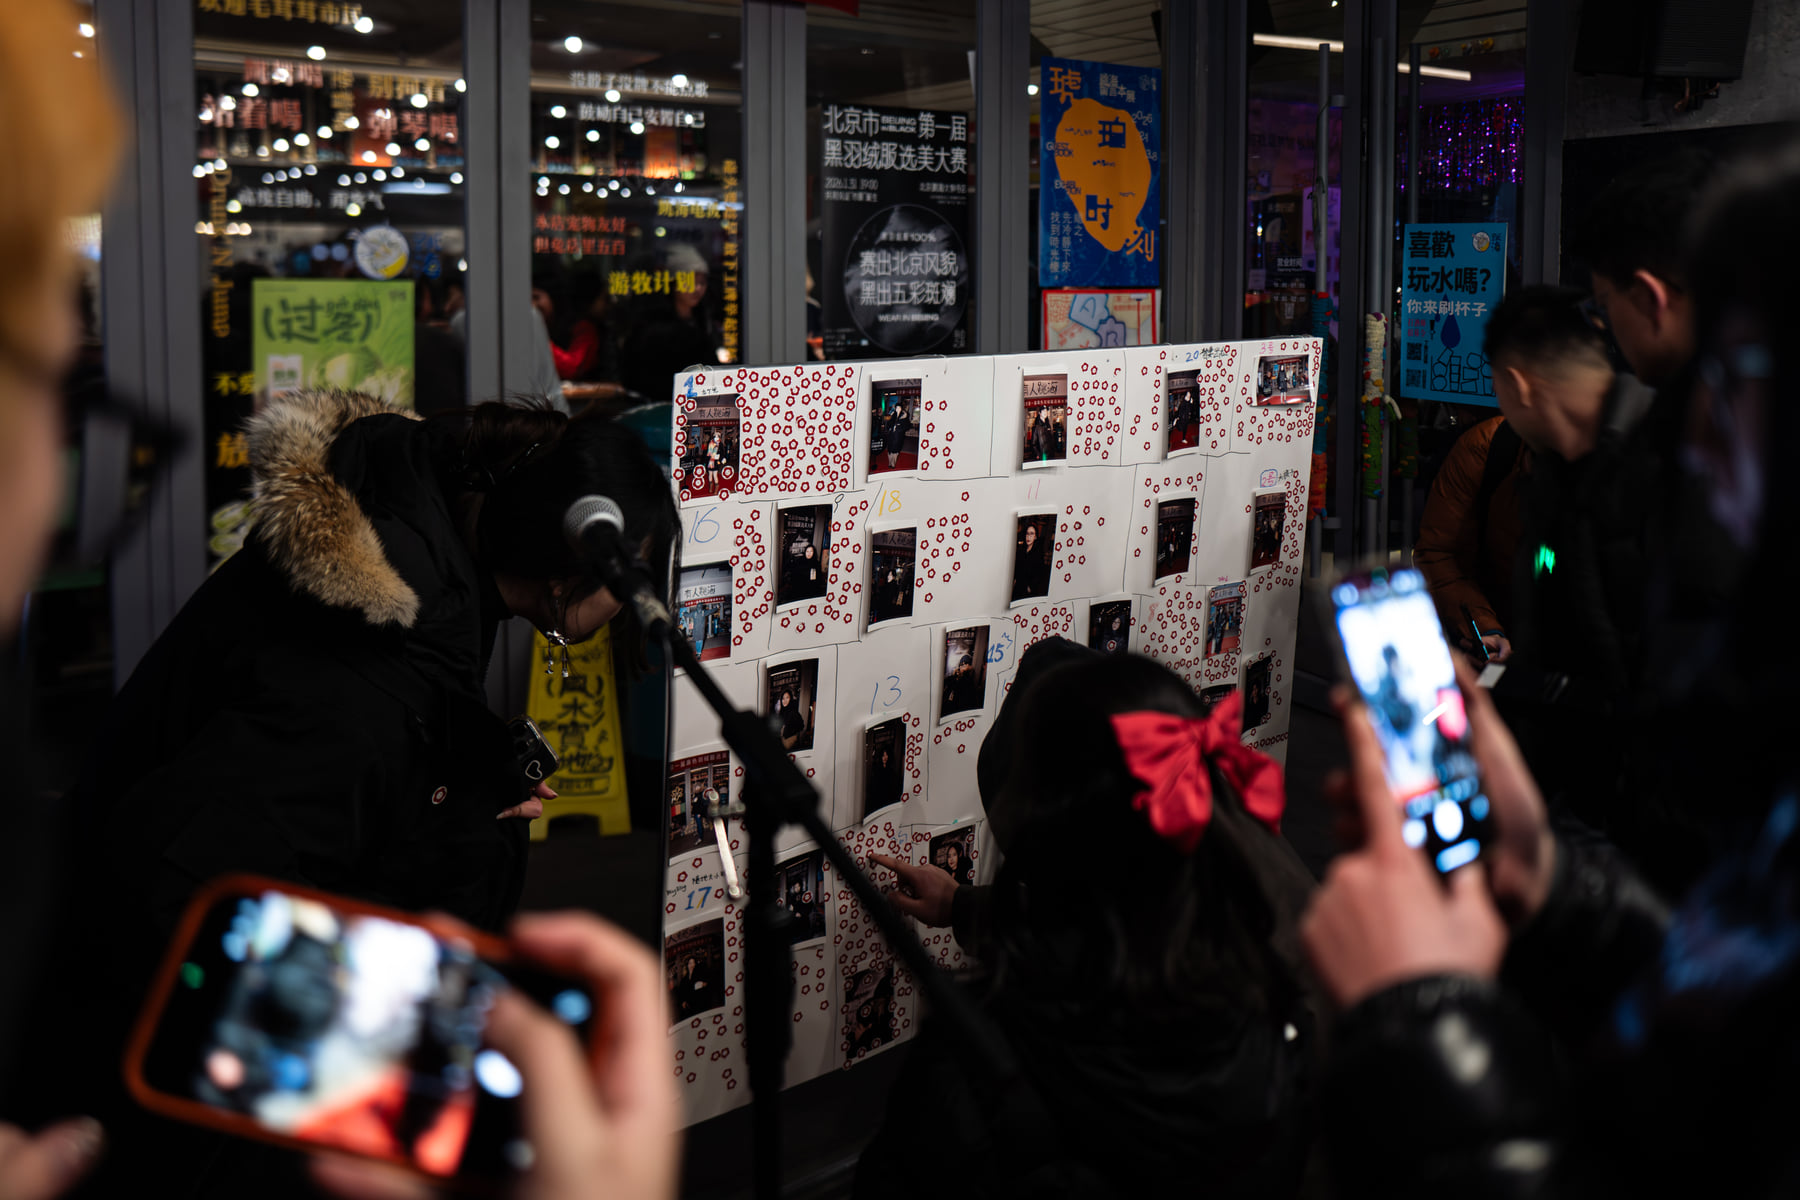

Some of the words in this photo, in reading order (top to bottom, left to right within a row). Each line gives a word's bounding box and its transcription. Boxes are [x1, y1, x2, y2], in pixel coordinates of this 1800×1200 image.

[823, 104, 880, 137] 北京市
[918, 111, 967, 142] 第一届
[824, 139, 967, 174] 黑羽绒服选美大赛
[1408, 230, 1456, 259] 喜歡
[860, 250, 958, 277] 赛出北京风貌
[609, 270, 696, 295] 游牧计划
[860, 281, 957, 306] 黑出五彩斑斓
[1406, 298, 1488, 318] 你来刷杯子
[1185, 350, 1200, 362] 20
[878, 490, 902, 517] 18
[688, 506, 720, 544] 16
[986, 643, 1005, 663] 15
[868, 675, 902, 715] 13
[684, 886, 712, 911] 17
